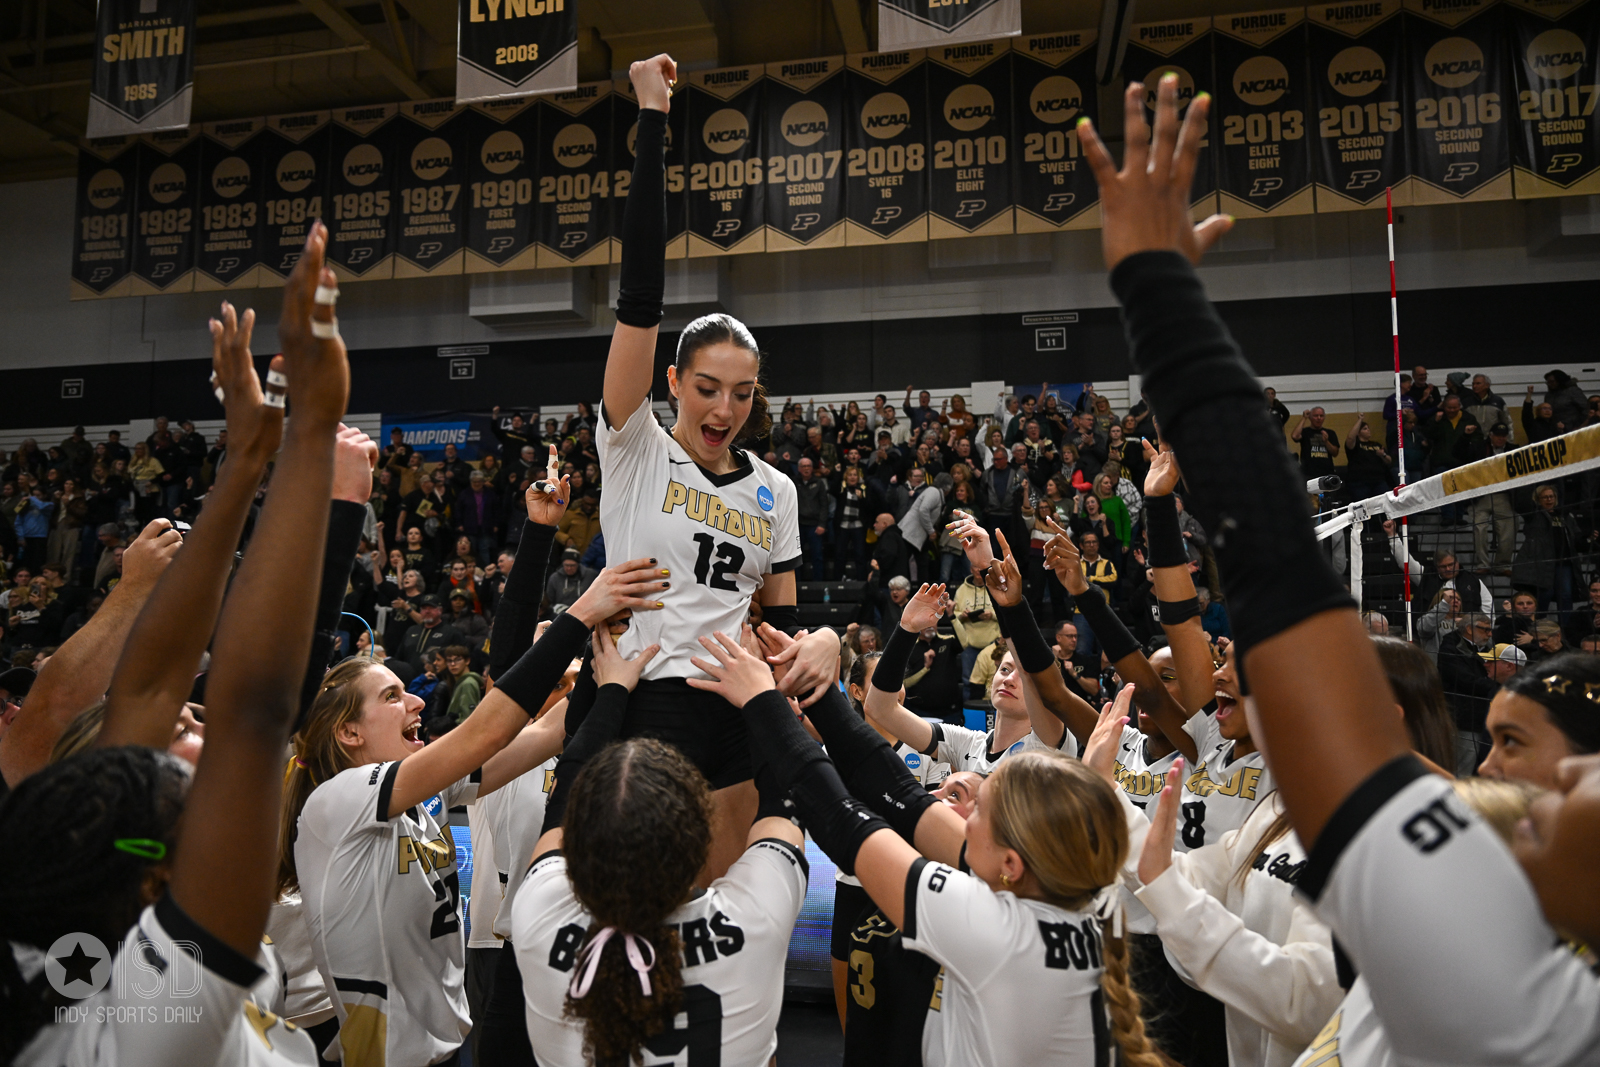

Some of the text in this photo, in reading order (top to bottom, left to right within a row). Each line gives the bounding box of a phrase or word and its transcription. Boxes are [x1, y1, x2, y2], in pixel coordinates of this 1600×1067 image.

[1326, 3, 1382, 20] PURDUE
[118, 18, 172, 29] MARIANNE
[1232, 13, 1286, 30] PURDUE
[1140, 23, 1193, 39] PURDUE
[102, 26, 185, 63] SMITH
[1030, 34, 1081, 51] PURDUE
[495, 43, 538, 65] 2008
[944, 44, 993, 60] PURDUE
[862, 53, 909, 68] PURDUE
[1534, 52, 1583, 68] NCAA
[782, 61, 828, 76] PURDUE
[1432, 60, 1481, 76] NCAA
[704, 70, 749, 85] PURDUE
[1335, 69, 1382, 85] NCAA
[124, 83, 157, 102] 1985
[1240, 78, 1287, 94] NCAA
[413, 101, 454, 115] PURDUE
[1036, 98, 1081, 113] NCAA
[1520, 84, 1600, 120] 2017
[346, 108, 384, 122] PURDUE
[950, 106, 993, 120] NCAA
[1416, 92, 1501, 129] 2016
[279, 115, 317, 129] PURDUE
[866, 114, 909, 128] NCAA
[1320, 101, 1401, 138] 2015
[1538, 119, 1586, 133] SECOND
[786, 121, 827, 136] NCAA
[1224, 110, 1304, 146] 2013
[1435, 128, 1483, 141] SECOND
[708, 129, 748, 143] NCAA
[1338, 135, 1384, 150] SECOND
[1542, 132, 1583, 146] ROUND
[558, 144, 595, 157] NCAA
[934, 135, 1007, 169] 2010
[1024, 130, 1085, 162] 201
[1249, 144, 1279, 158] ELITE
[1439, 141, 1480, 155] ROUND
[486, 151, 524, 164] NCAA
[848, 143, 925, 177] 2008
[1342, 149, 1382, 163] ROUND
[347, 164, 382, 176] NCAA
[415, 158, 451, 170] NCAA
[768, 150, 843, 184] 2007
[1039, 161, 1076, 174] SWEET
[1249, 157, 1280, 170] EIGHT
[280, 170, 315, 182] NCAA
[614, 165, 684, 197] 25
[690, 157, 763, 191] 2006
[957, 168, 984, 180] ELITE
[1053, 174, 1064, 185] 16
[154, 182, 186, 194] NCAA
[216, 176, 250, 188] NCAA
[539, 171, 609, 203] 2004
[786, 182, 825, 195] SECOND
[868, 175, 904, 188] SWEET
[956, 180, 985, 192] EIGHT
[92, 187, 122, 199] NCAA
[401, 184, 461, 214] 1987
[471, 178, 532, 208] 1990
[709, 189, 743, 201] SWEET
[789, 194, 822, 206] ROUND
[881, 188, 892, 199] 16
[266, 196, 322, 225] 1984
[333, 190, 390, 220] 1985
[556, 202, 592, 214] SECOND
[721, 201, 732, 212] 16
[202, 202, 257, 230] 1983
[409, 213, 450, 224] REGIONAL
[489, 208, 514, 218] FIRST
[558, 213, 589, 225] ROUND
[81, 213, 128, 240] 1981
[140, 208, 192, 235] 1982
[341, 219, 381, 230] REGIONAL
[486, 219, 516, 230] ROUND
[210, 230, 248, 241] REGIONAL
[282, 225, 305, 235] FIRST
[335, 229, 386, 241] SEMIFINALS
[404, 224, 456, 236] SEMIFINALS
[85, 240, 120, 250] REGIONAL
[146, 235, 183, 246] REGIONAL
[204, 240, 252, 252] SEMIFINALS
[80, 250, 125, 261] SEMIFINALS
[150, 246, 178, 256] FINALS
[1046, 338, 1056, 346] 11
[400, 429, 467, 445] HAMPIONS
[1506, 439, 1567, 478] BOILER UP
[759, 495, 772, 507] NCAA
[662, 478, 772, 552] PURDUE
[693, 533, 745, 592] 12
[1182, 800, 1206, 849] 8
[1037, 918, 1104, 970] BOI
[850, 949, 875, 1010] 3
